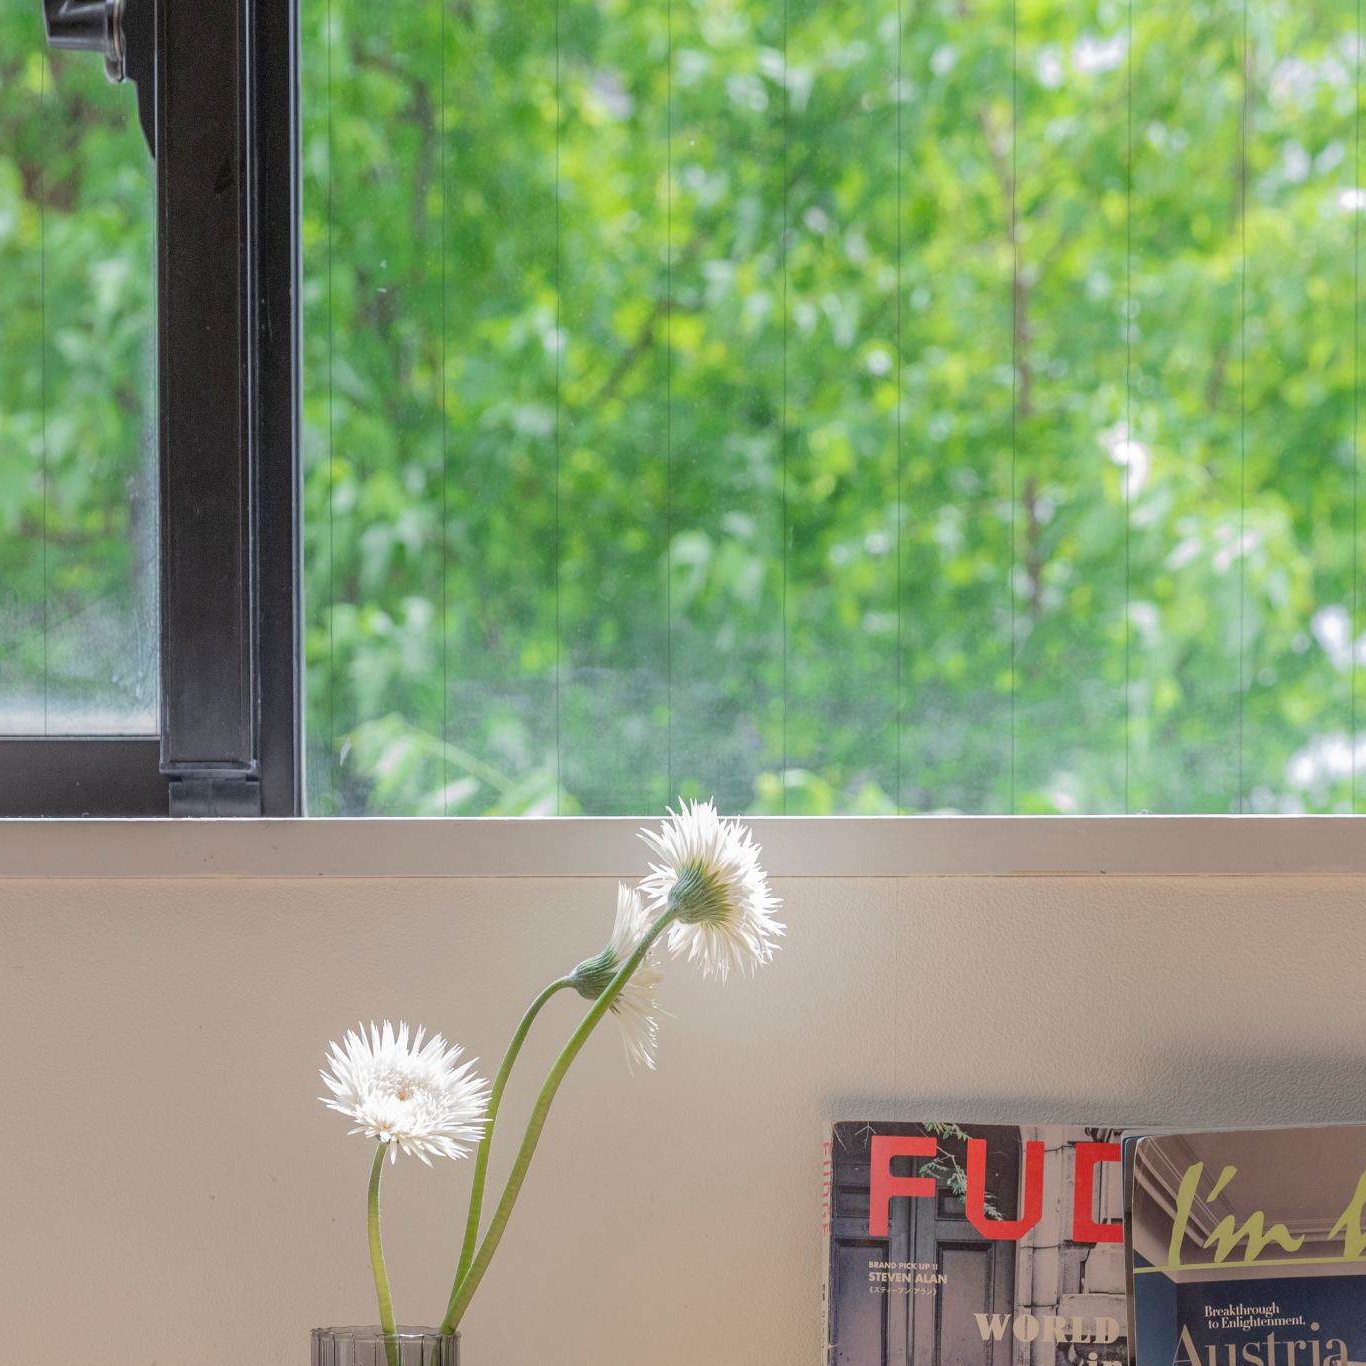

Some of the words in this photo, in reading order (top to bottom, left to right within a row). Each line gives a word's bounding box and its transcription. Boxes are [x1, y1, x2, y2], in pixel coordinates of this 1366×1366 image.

[868, 1261, 897, 1269] BRAND
[899, 1262, 917, 1270] PICK
[918, 1263, 930, 1271] UP
[868, 1272, 912, 1283] STEVEN
[914, 1273, 948, 1284] ALAN
[1204, 1301, 1280, 1318] Breakthrough
[974, 1313, 1120, 1343] WORLD
[1208, 1318, 1219, 1330] to
